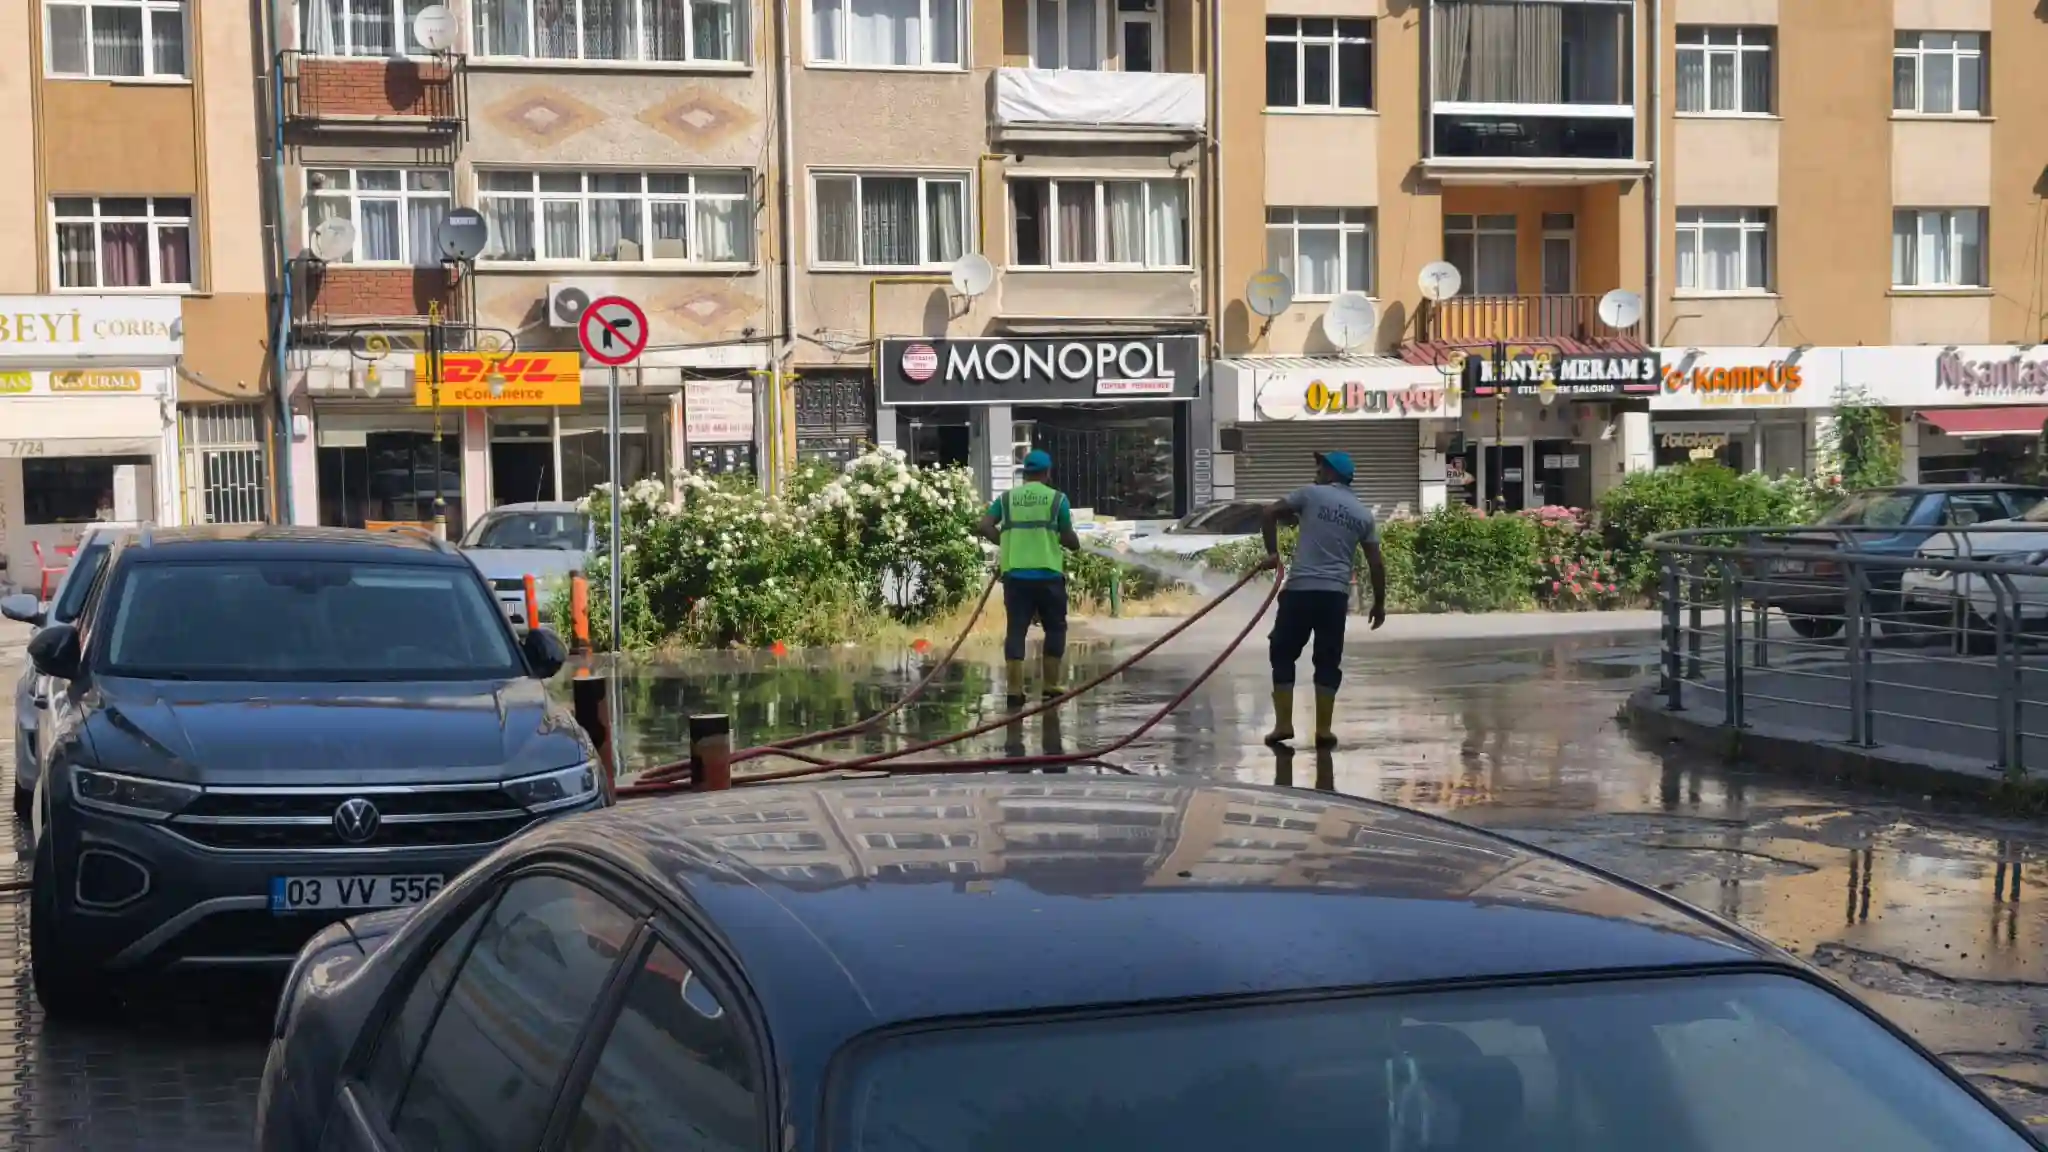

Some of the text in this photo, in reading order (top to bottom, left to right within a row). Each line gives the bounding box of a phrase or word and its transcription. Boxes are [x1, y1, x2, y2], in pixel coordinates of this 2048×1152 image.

[442, 358, 558, 383] DHL
[945, 341, 1175, 381] MONOPOL
[1560, 358, 1639, 381] MERAM
[1642, 358, 1654, 381] 3
[10, 442, 44, 454] 7/24
[287, 880, 322, 905] 03
[337, 878, 376, 904] VV
